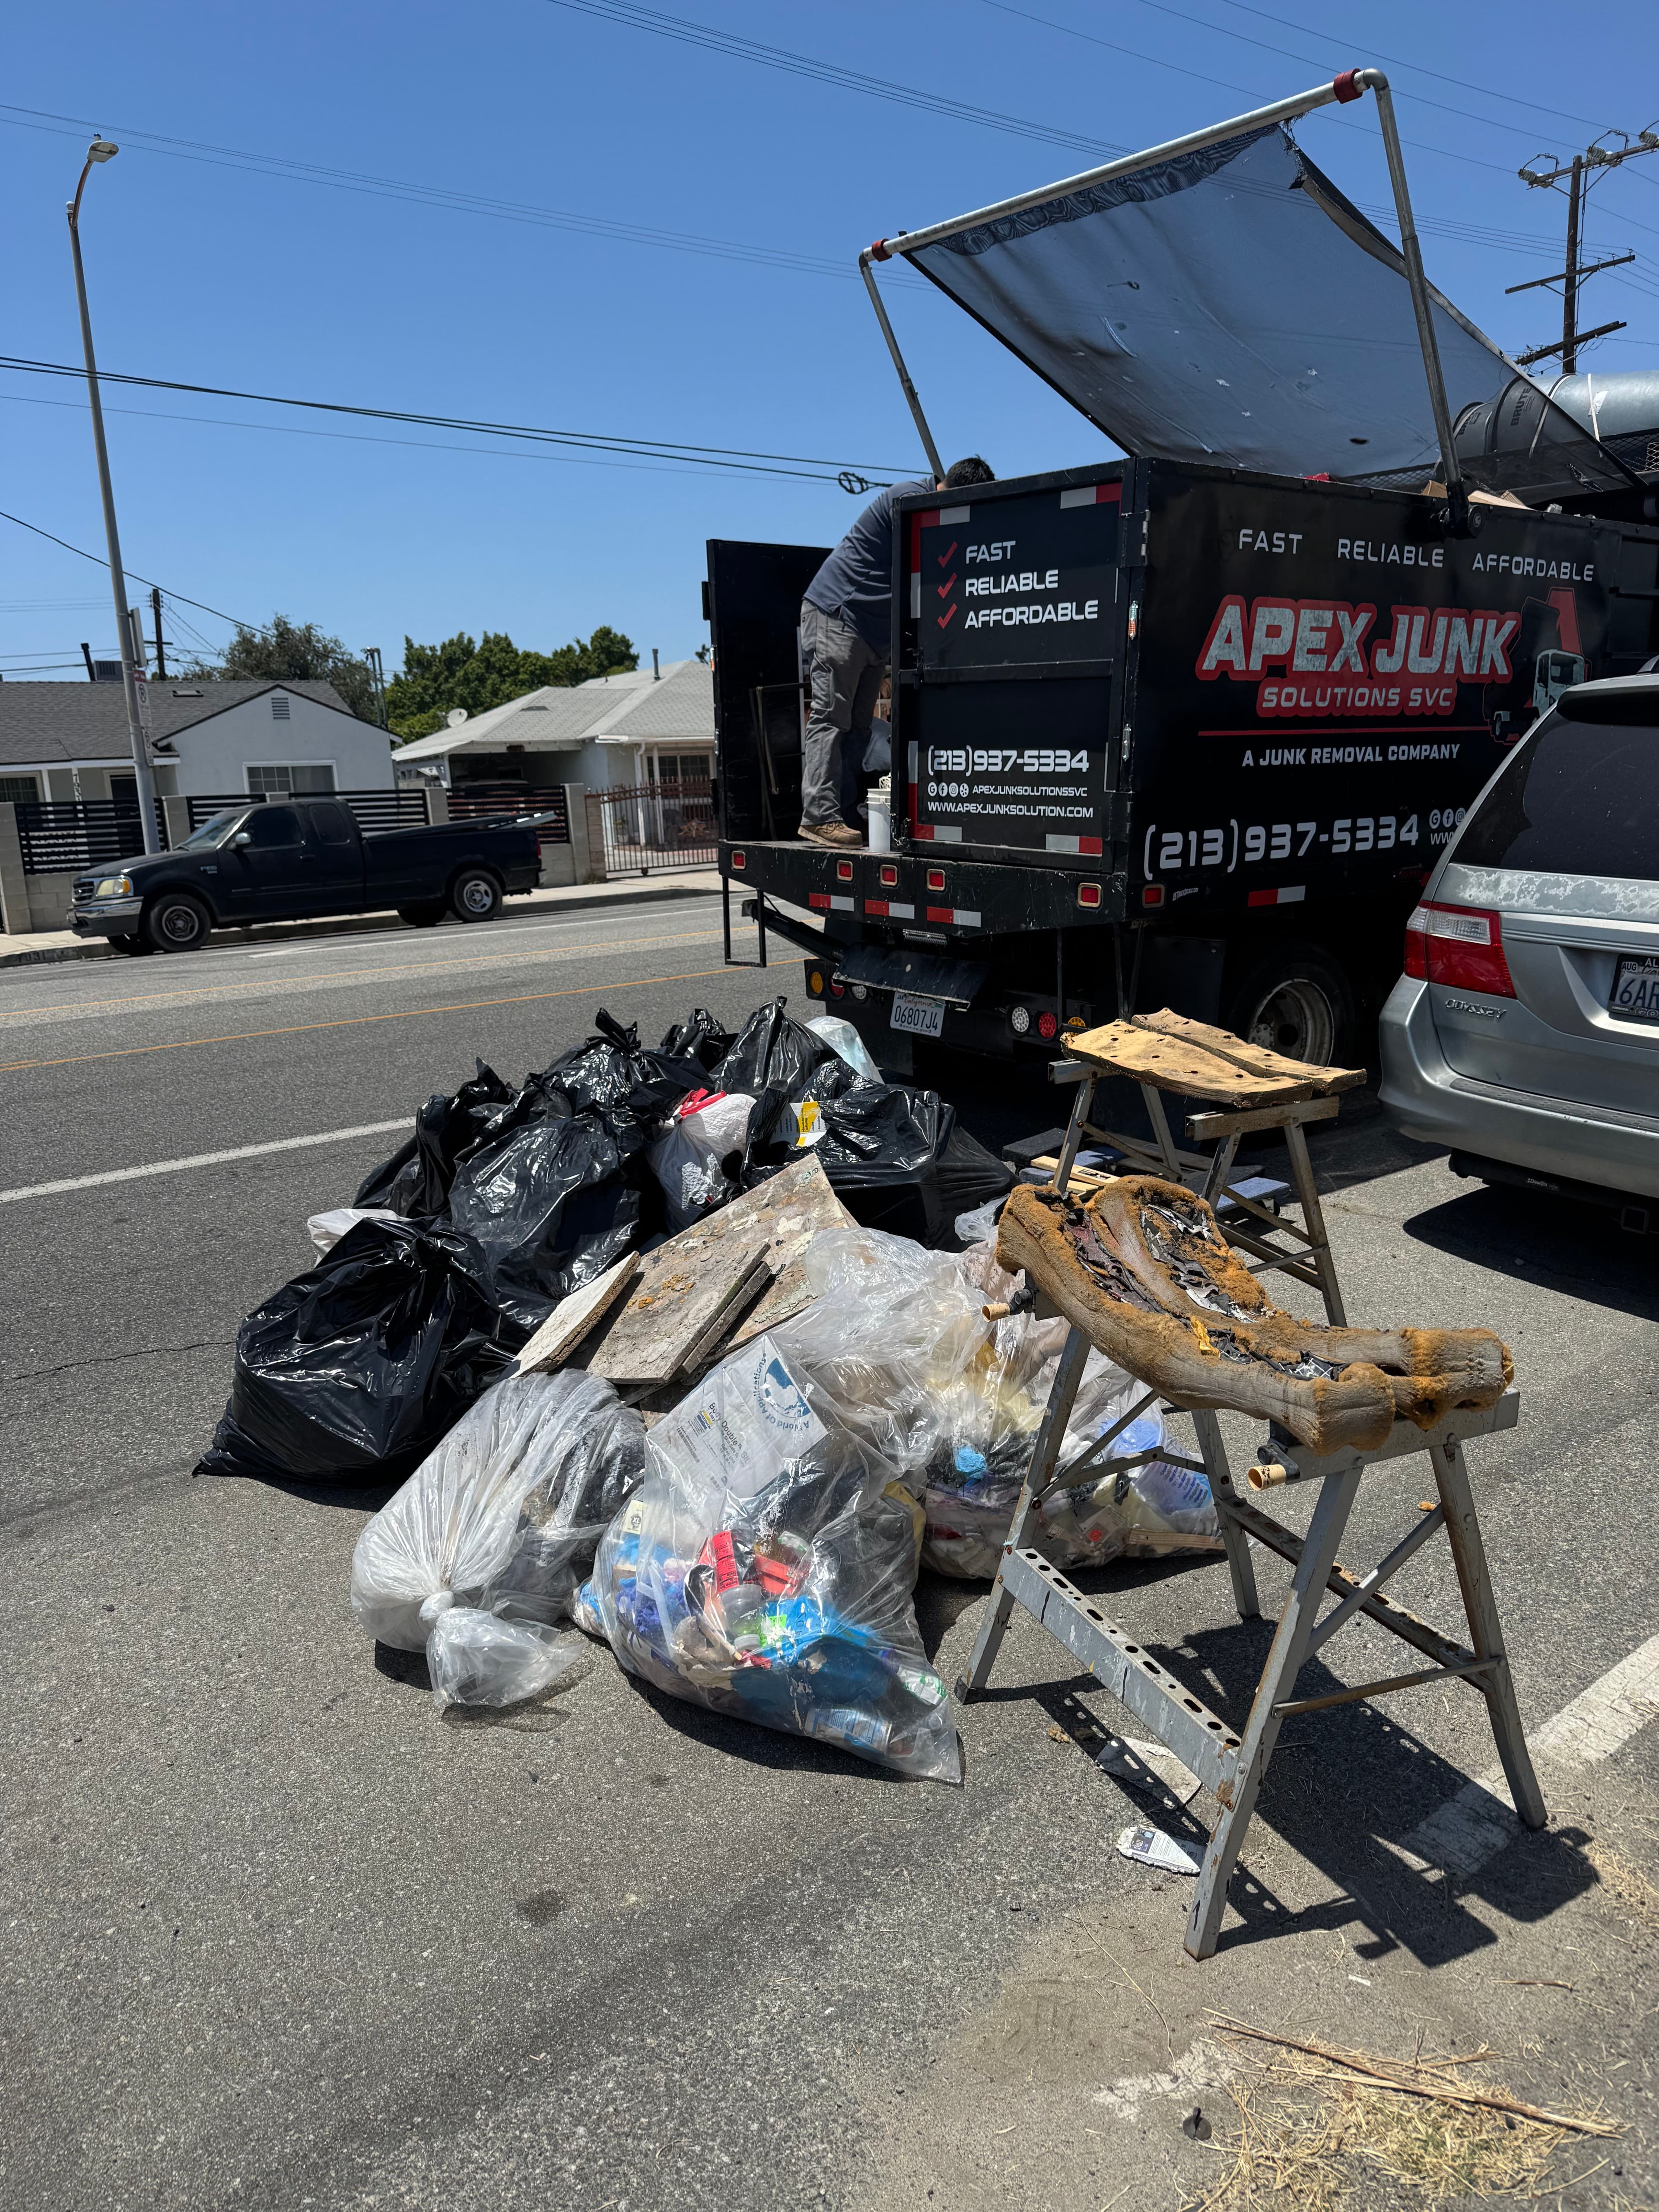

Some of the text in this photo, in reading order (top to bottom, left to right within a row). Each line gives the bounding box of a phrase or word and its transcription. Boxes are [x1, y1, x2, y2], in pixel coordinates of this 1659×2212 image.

[1511, 387, 1532, 426] BRUTE
[966, 541, 1016, 564] FAST
[1239, 529, 1594, 581] FAST RELIABLE AFFORDABLE
[966, 569, 1058, 597] RELIABLE
[964, 600, 1098, 629] AFFORDABLE
[1202, 605, 1516, 674] APEX JUNK
[1262, 687, 1452, 707] SOLUTIONS SVC
[928, 745, 1089, 777] (213)937-5334
[1242, 744, 1460, 767] A JUNK REMOVAL COMPANY
[972, 785, 1087, 797] APEXJUNKSOLUTIONSSVC
[928, 801, 1093, 818] WWW.APEXJUNKSOLUTION.COM
[1622, 962, 1637, 971] AUG
[894, 1005, 938, 1031] 06807J4
[1445, 998, 1507, 1018] ODYSSEY
